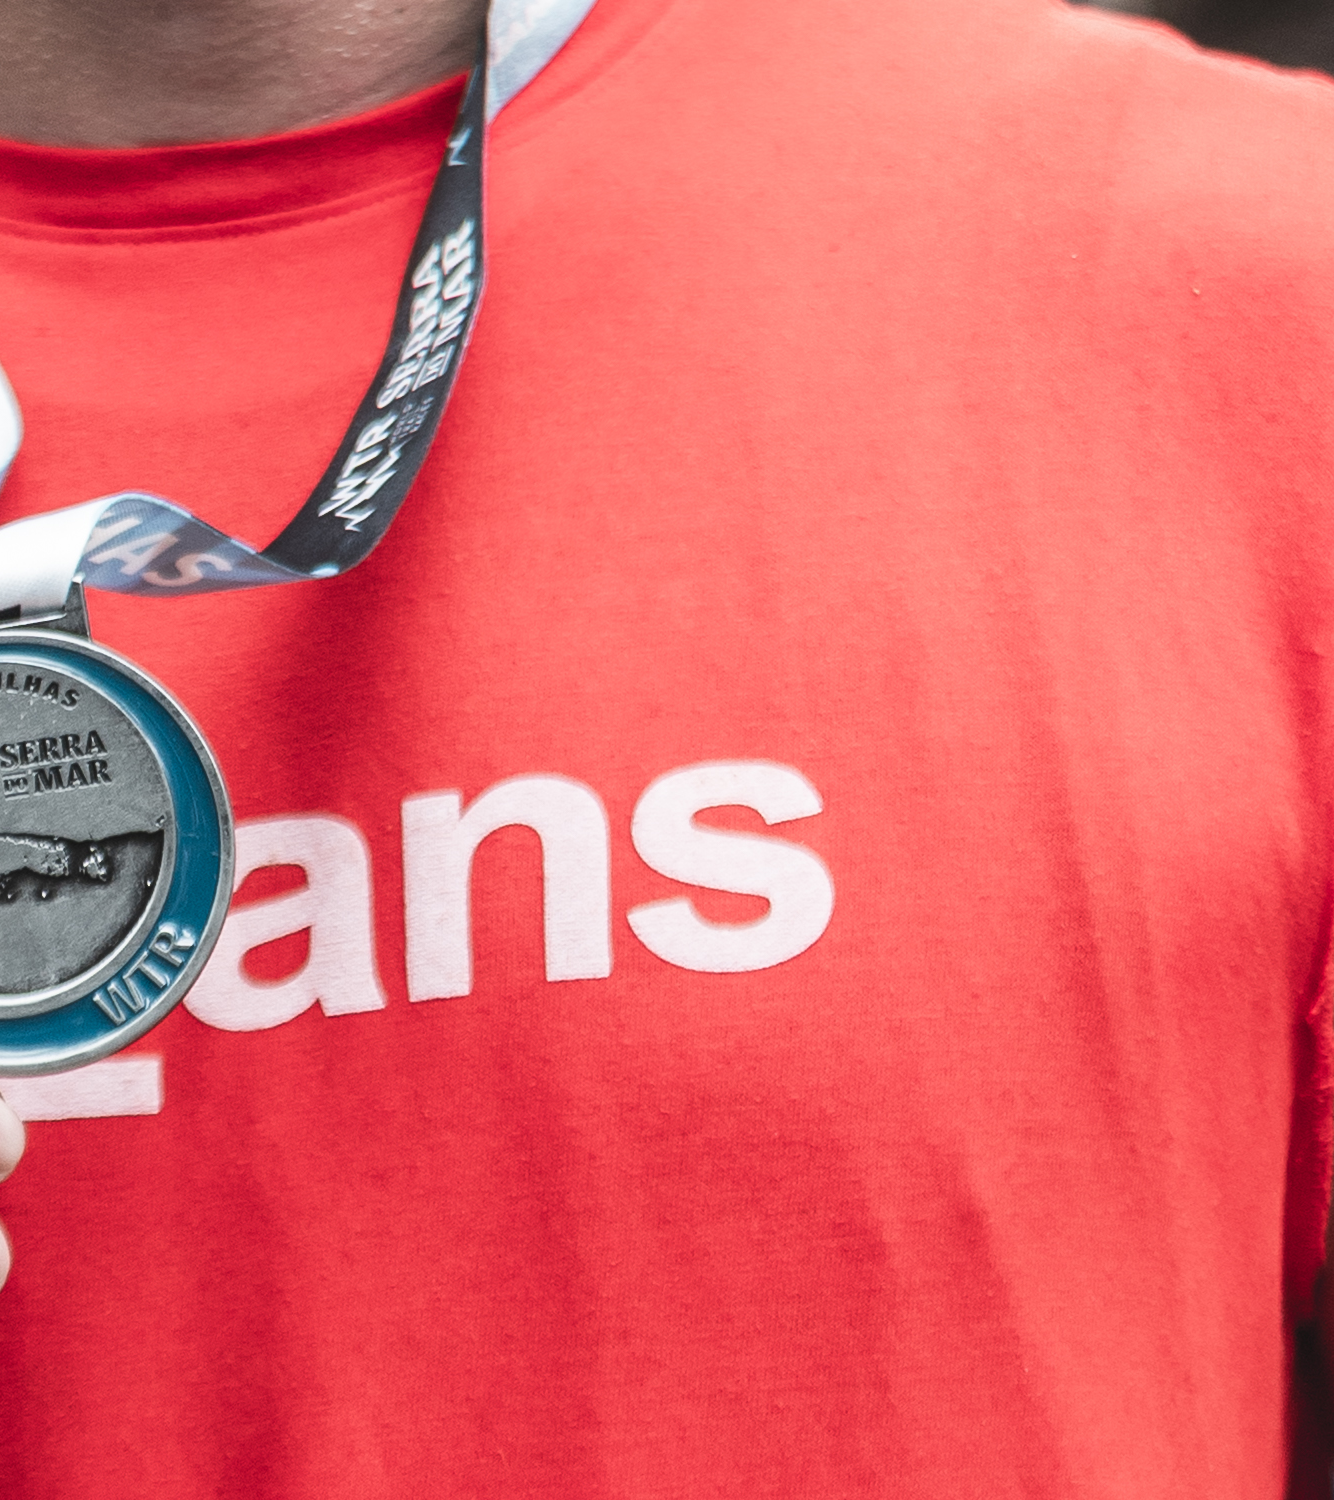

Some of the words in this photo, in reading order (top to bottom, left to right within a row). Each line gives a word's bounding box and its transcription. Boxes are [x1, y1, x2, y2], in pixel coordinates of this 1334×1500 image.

[432, 218, 475, 353] MAR
[318, 413, 398, 517] WTR
[376, 242, 440, 409] SERRA
[33, 758, 112, 797] MAR
[93, 922, 196, 1026] WTR
[107, 758, 835, 1075] ans
